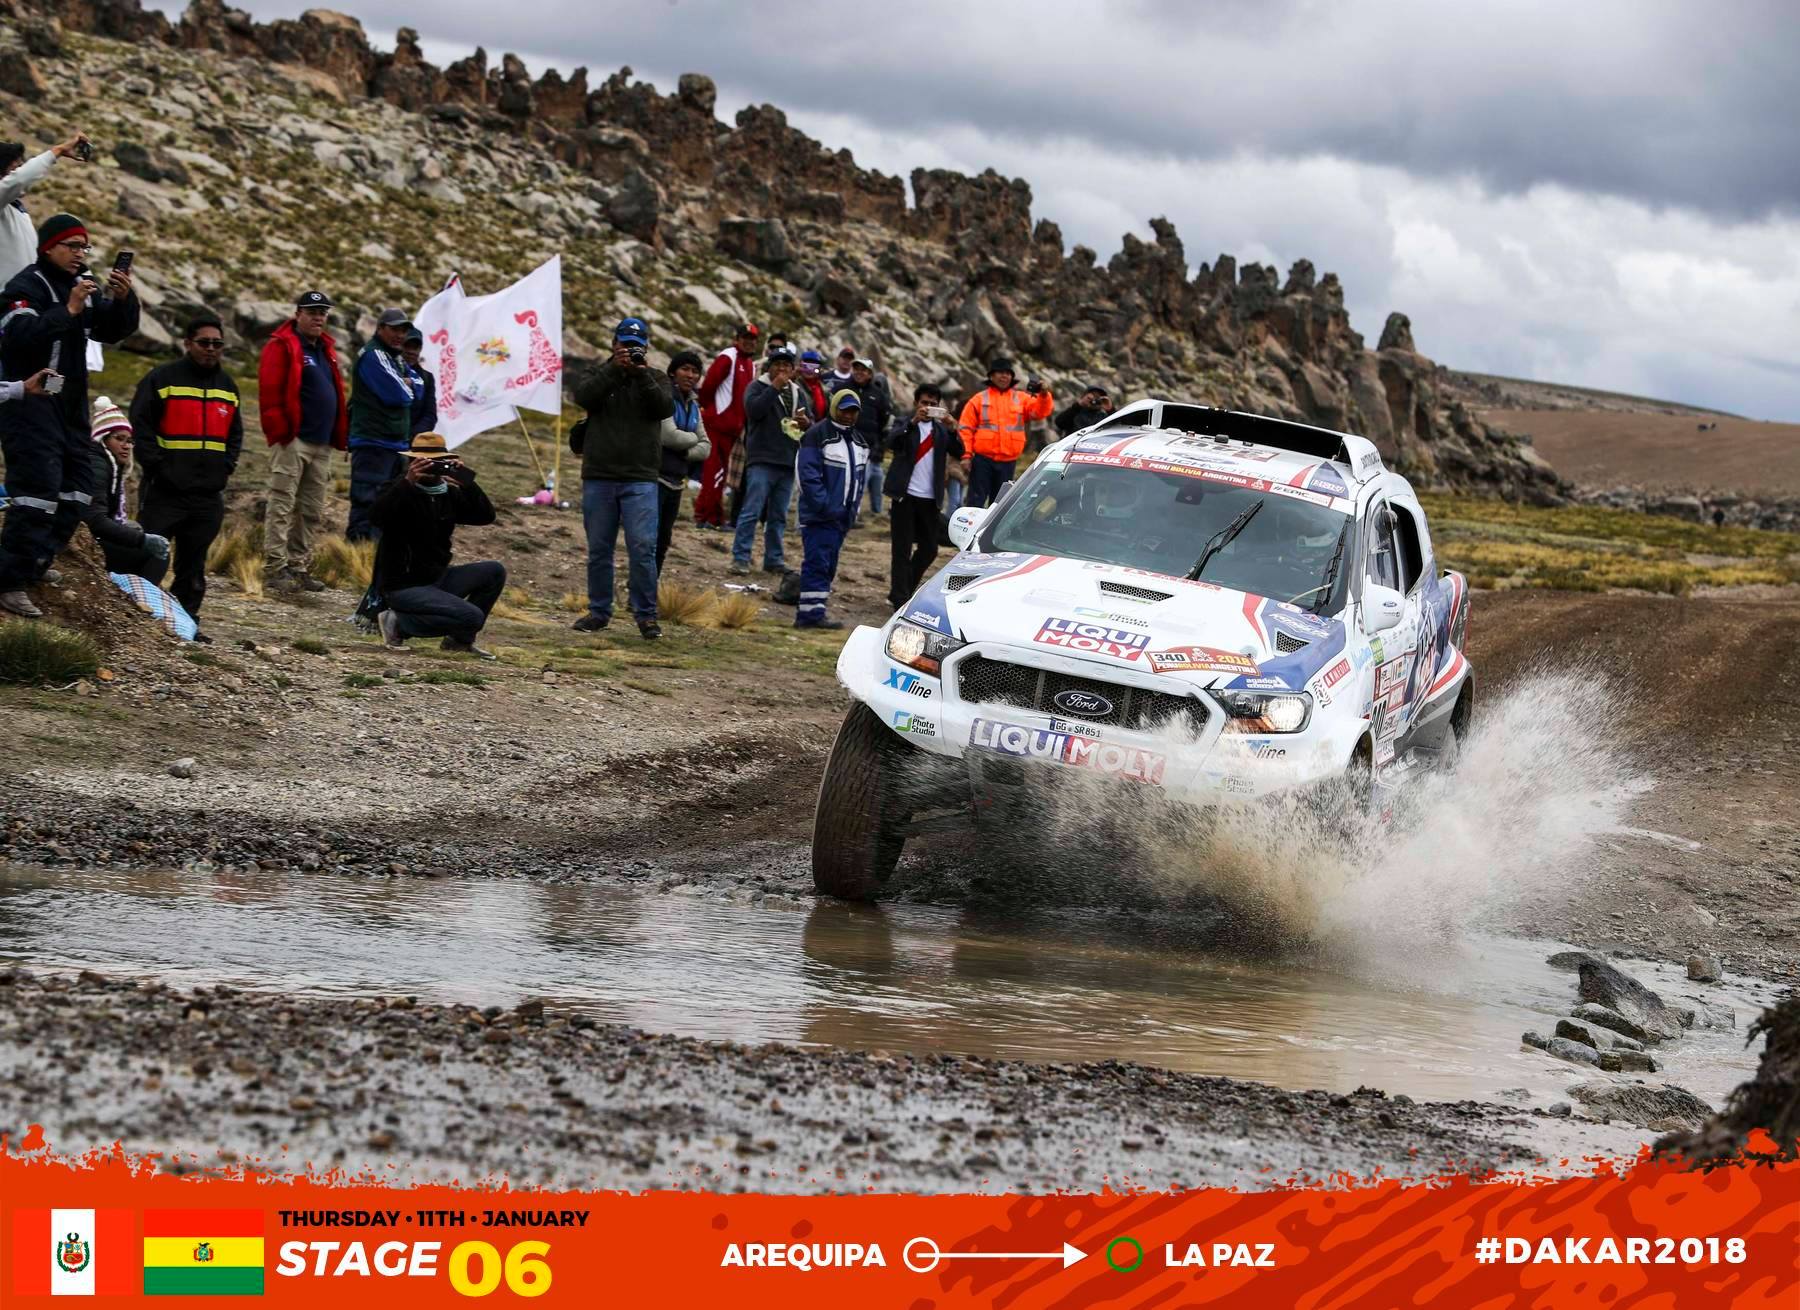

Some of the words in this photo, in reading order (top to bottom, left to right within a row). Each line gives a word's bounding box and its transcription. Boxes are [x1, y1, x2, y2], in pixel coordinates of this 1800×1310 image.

[1070, 455, 1121, 463] MOTUL
[1149, 462, 1171, 471] PERU
[1171, 466, 1202, 476] BOLIVIA
[1201, 471, 1247, 485] ARGENTINA
[1046, 618, 1148, 648] LIQUI
[1039, 631, 1143, 660] MOLY
[1154, 653, 1185, 662] 340
[1216, 655, 1252, 666] 2018
[882, 668, 932, 699] XTline
[1066, 693, 1099, 711] Ford
[911, 725, 935, 737] Studio
[912, 718, 935, 729] Photo
[973, 720, 1065, 760] LIQUI
[1069, 738, 1164, 785] MOLY
